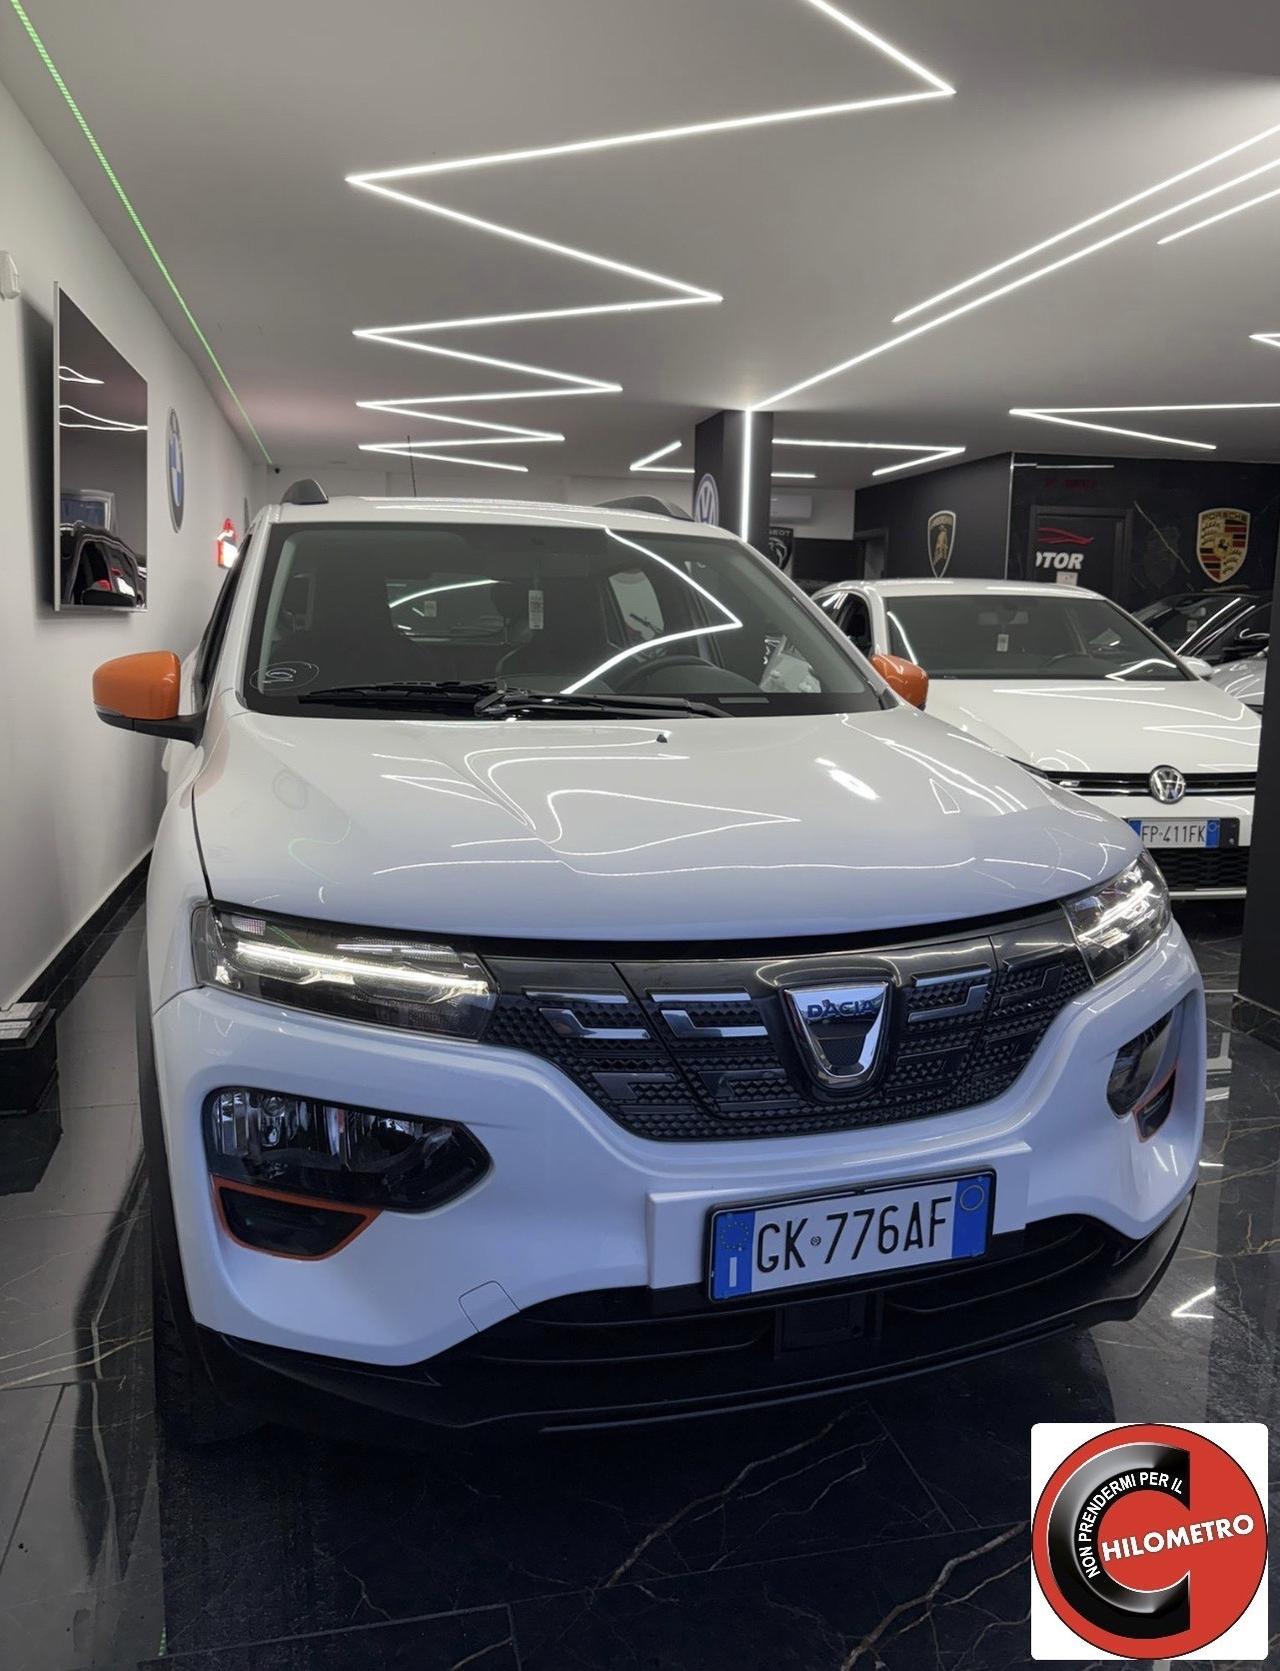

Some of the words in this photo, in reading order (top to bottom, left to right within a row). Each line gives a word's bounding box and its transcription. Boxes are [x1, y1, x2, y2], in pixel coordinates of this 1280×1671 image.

[1141, 825, 1159, 843] FP
[1163, 825, 1206, 843] 411FK
[807, 1000, 874, 1019] DACIA
[757, 1217, 808, 1273] GK
[824, 1196, 952, 1265] 776AF
